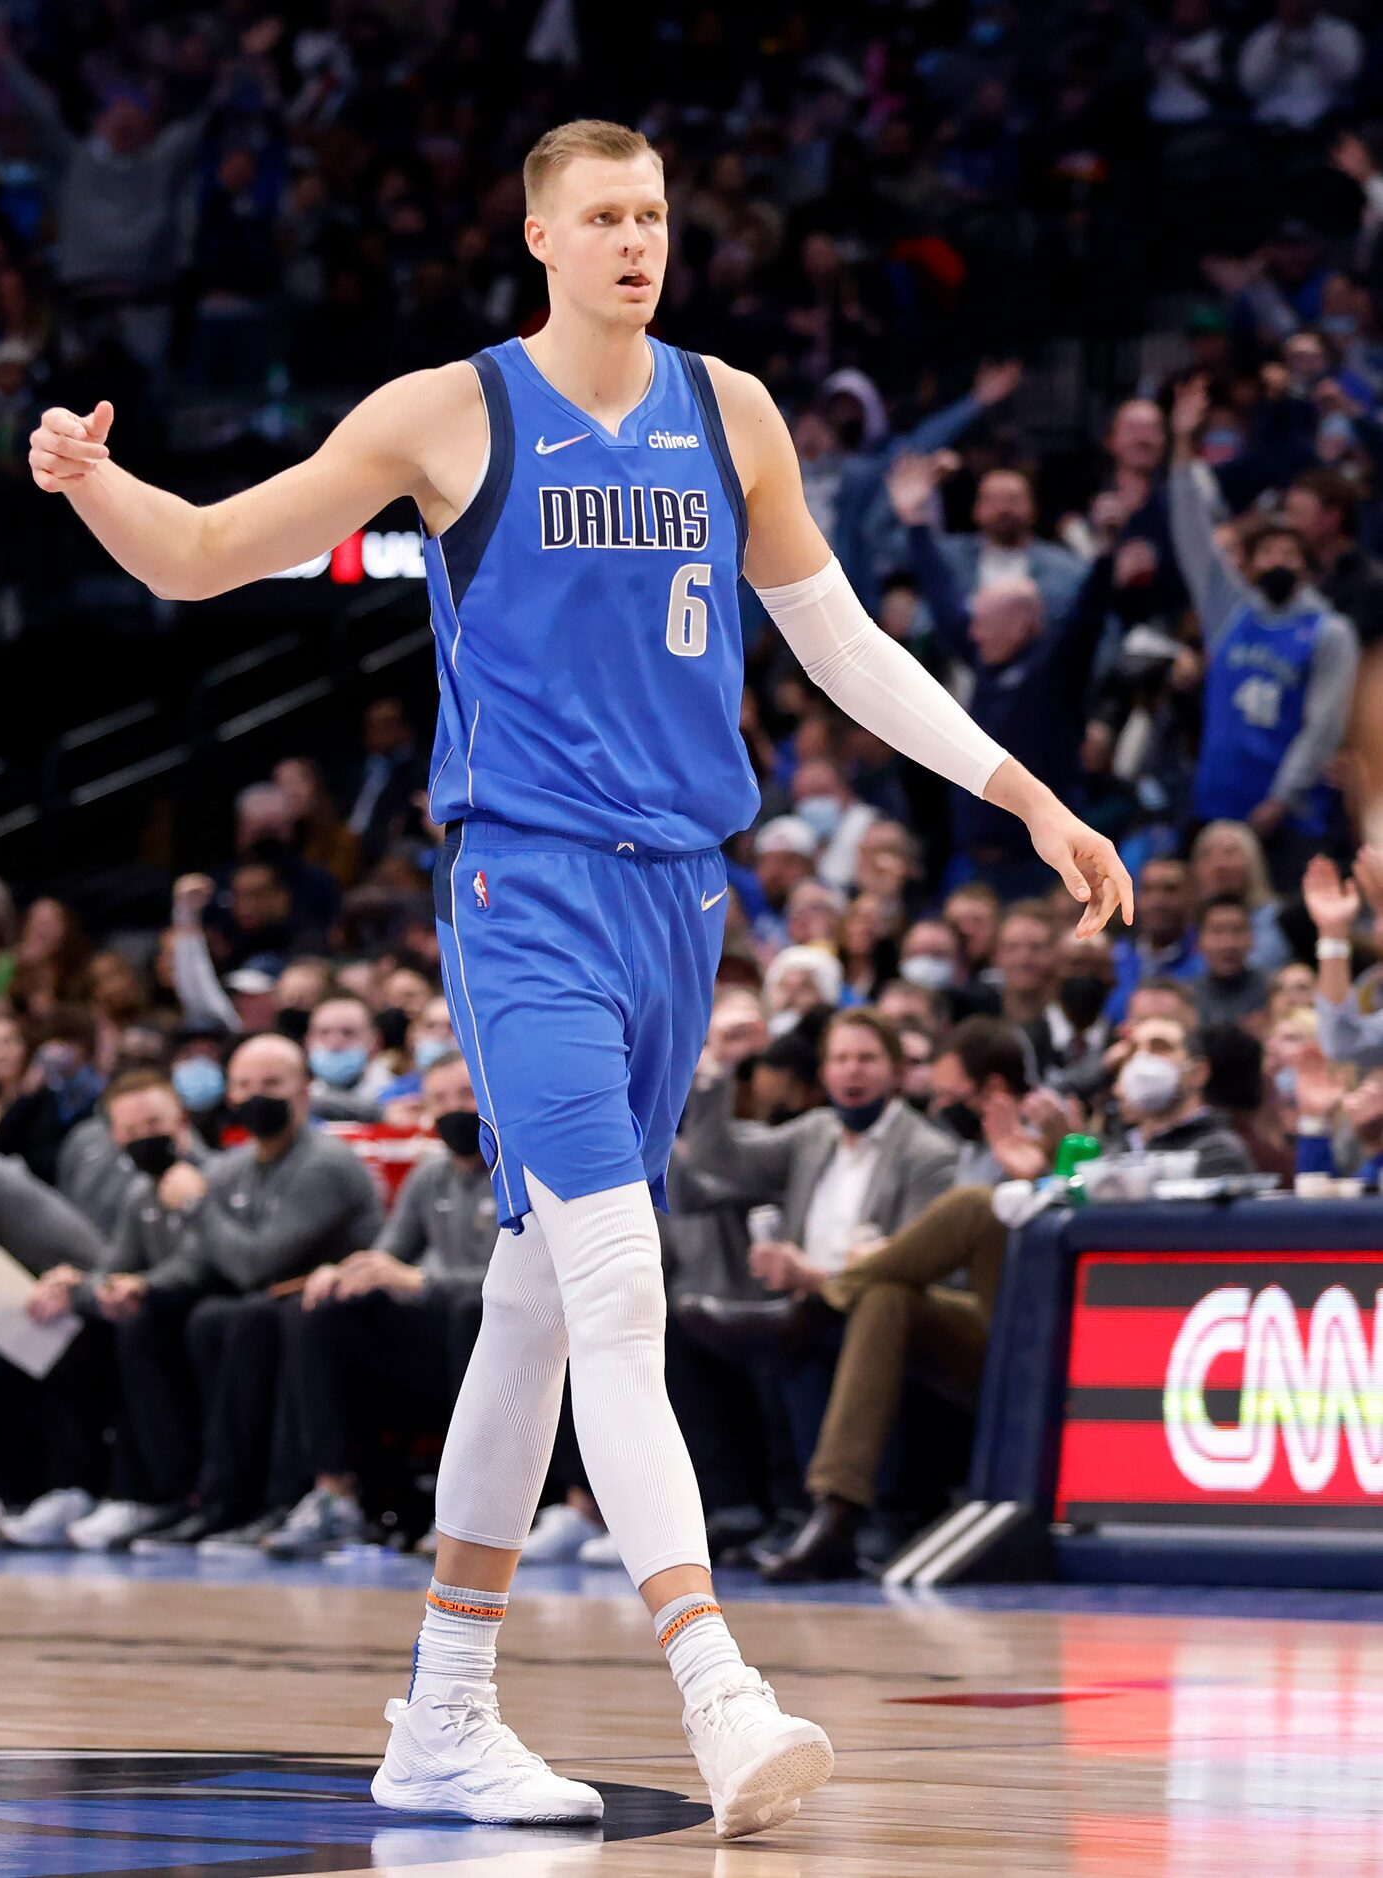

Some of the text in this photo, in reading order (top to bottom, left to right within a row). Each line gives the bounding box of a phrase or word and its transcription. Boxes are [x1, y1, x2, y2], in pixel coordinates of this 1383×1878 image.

[648, 431, 699, 448] chime
[539, 486, 708, 551] DALLAS
[666, 563, 712, 657] 6
[1163, 1284, 1383, 1494] CNN
